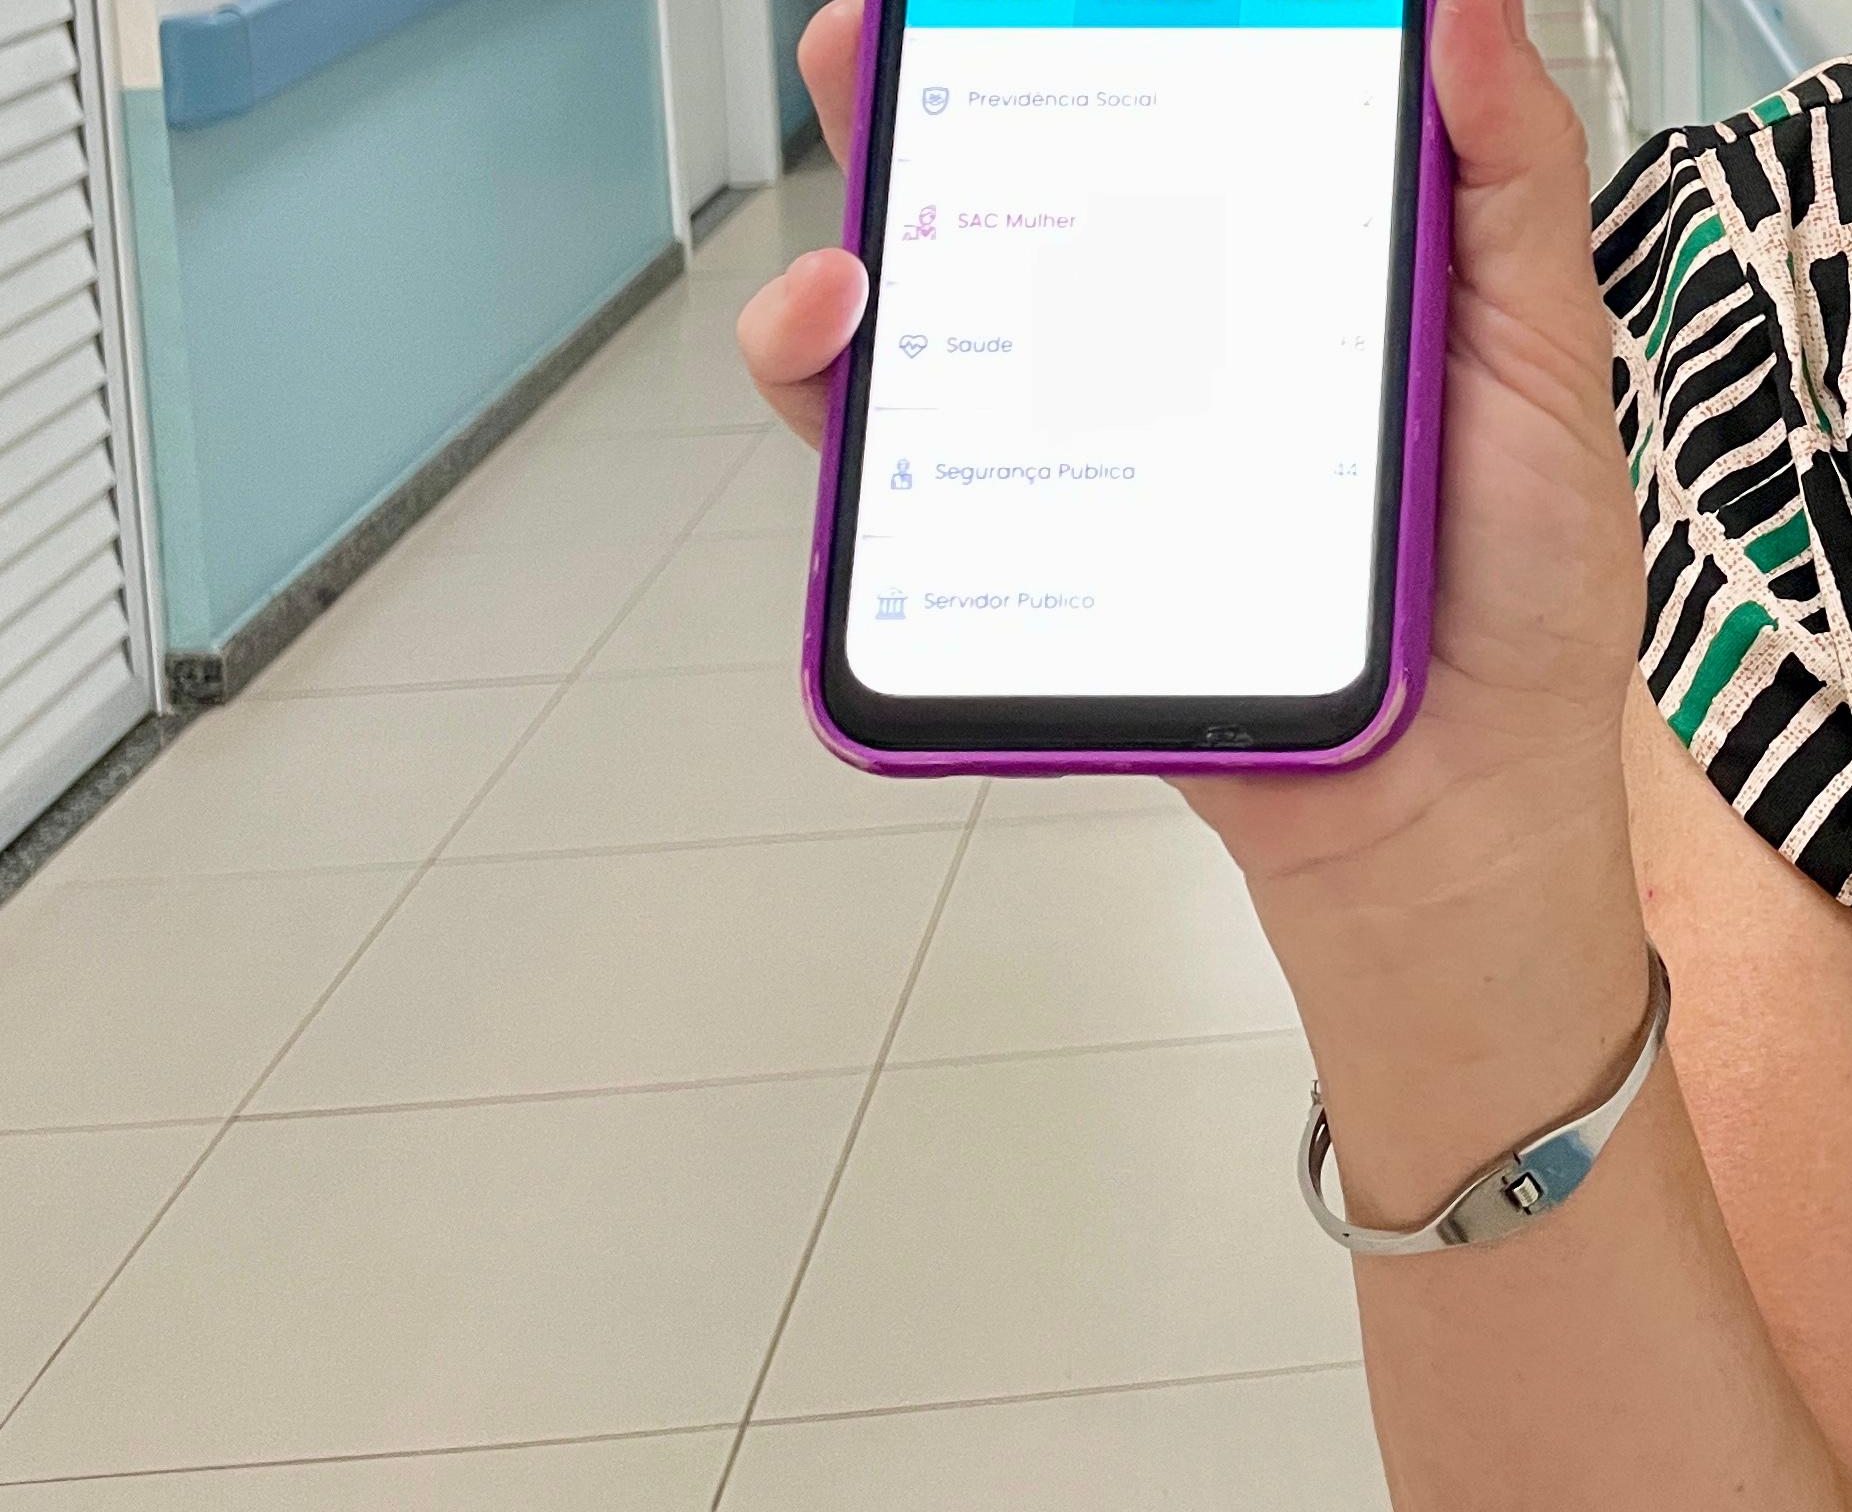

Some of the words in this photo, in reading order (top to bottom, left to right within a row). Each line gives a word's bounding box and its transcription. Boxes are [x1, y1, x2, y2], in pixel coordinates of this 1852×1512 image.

[1095, 90, 1158, 108] Social
[957, 212, 999, 230] SAC
[1005, 212, 1077, 230] Mulher
[934, 463, 1052, 486] Segurança
[923, 591, 1011, 610] Servidor
